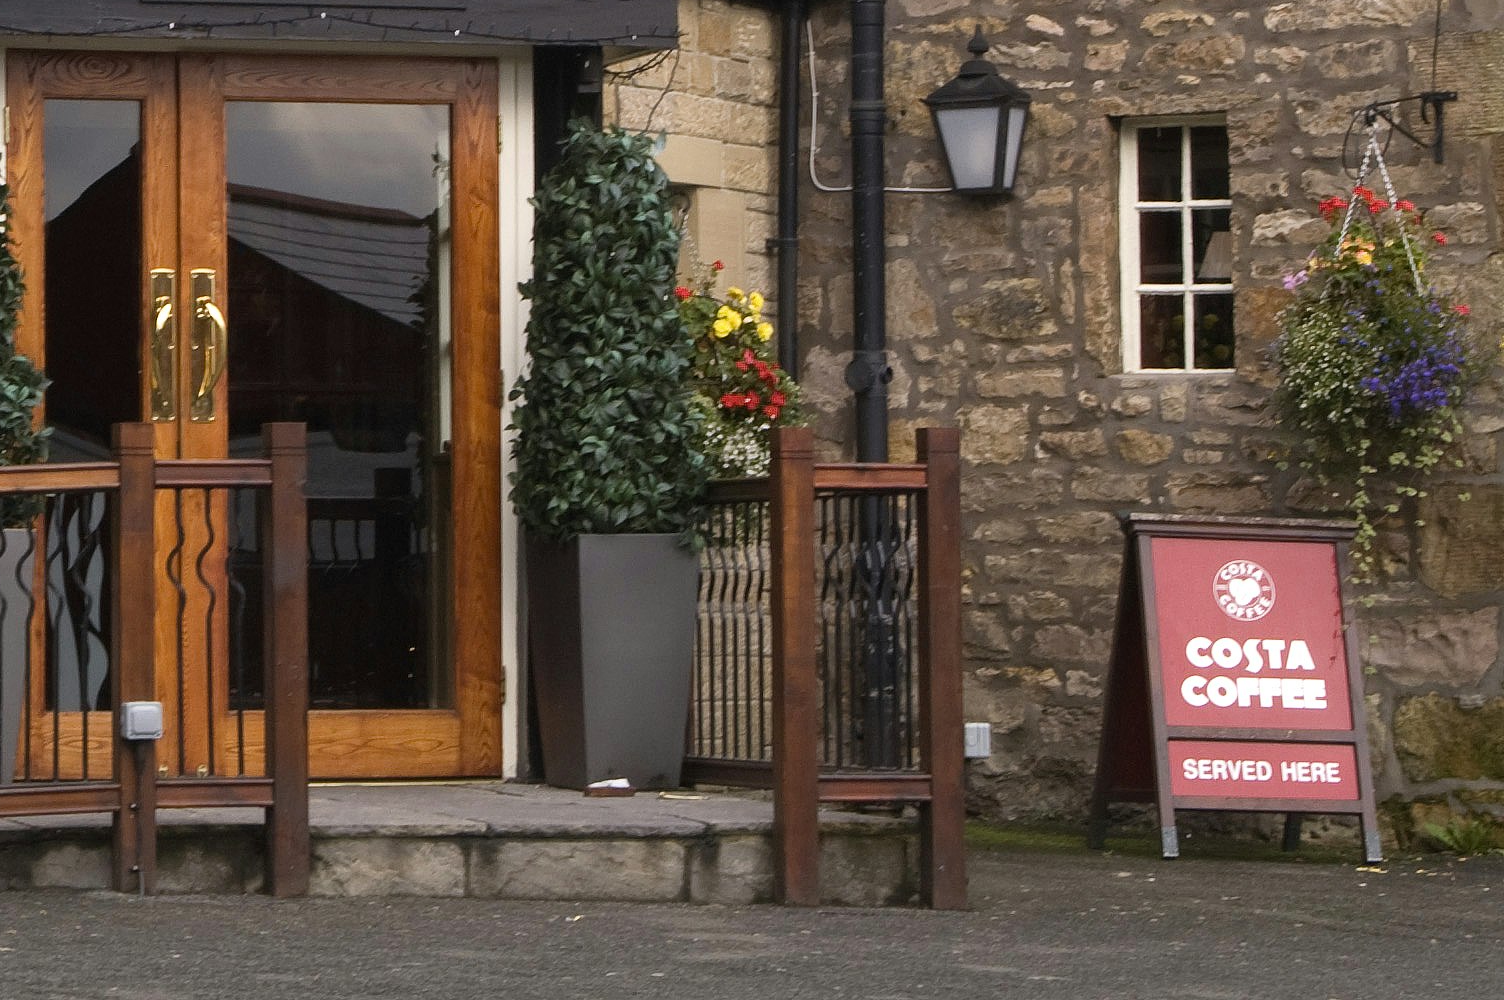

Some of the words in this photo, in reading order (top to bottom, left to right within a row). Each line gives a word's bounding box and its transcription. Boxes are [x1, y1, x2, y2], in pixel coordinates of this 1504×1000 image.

[1220, 562, 1264, 581] COSTA
[1219, 594, 1272, 619] COFFEE
[1185, 636, 1316, 674] COSTA
[1181, 675, 1328, 710] COFFEE
[1182, 758, 1273, 782] SERVED
[1280, 761, 1342, 784] HERE
